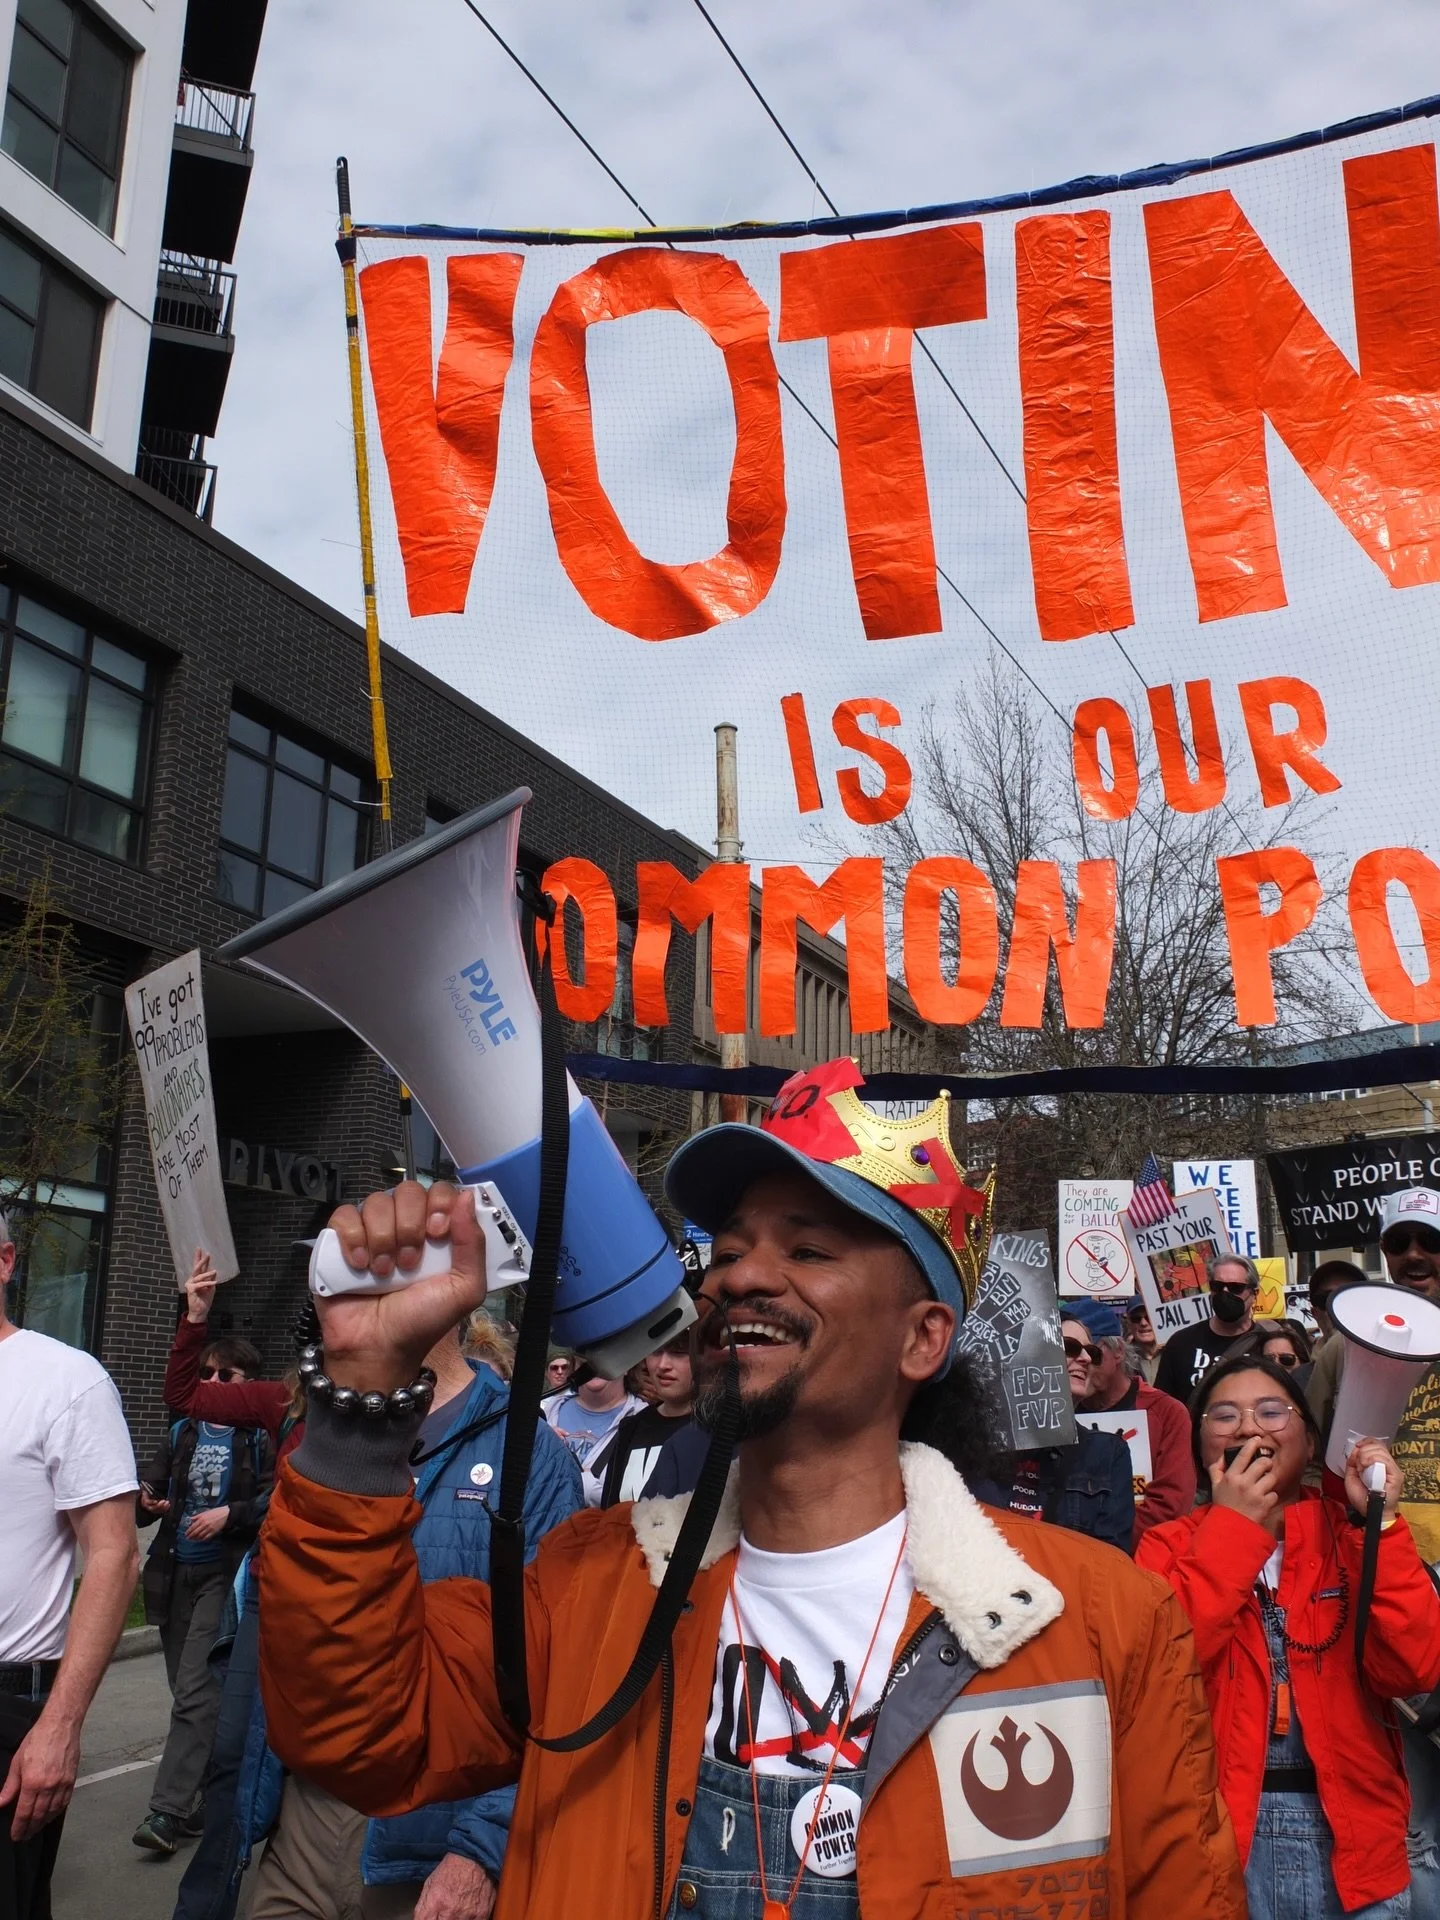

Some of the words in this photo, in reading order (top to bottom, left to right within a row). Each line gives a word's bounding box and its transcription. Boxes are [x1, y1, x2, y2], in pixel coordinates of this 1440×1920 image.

[780, 692, 913, 825] IS
[1073, 676, 1343, 822] OUR
[536, 856, 1116, 1037] OMMON
[442, 975, 487, 1056] PyleUSA.com
[460, 958, 517, 1047] PYLE
[135, 1024, 159, 1072] 99
[155, 1013, 205, 1066] PROBLEMS
[163, 1066, 178, 1091] AND
[157, 1152, 175, 1182] ARE
[175, 1113, 201, 1151] MOST
[168, 1174, 182, 1199] OF
[181, 1143, 209, 1180] THEM
[1188, 1165, 1232, 1186] WE
[1333, 1159, 1424, 1189] PEOPLE
[1064, 1184, 1088, 1199] They
[1092, 1187, 1108, 1196] are
[1064, 1197, 1119, 1211] COMING
[1291, 1201, 1359, 1226] STAND
[992, 1233, 1049, 1269] KINGS
[1136, 1227, 1169, 1252] PAST
[1173, 1217, 1216, 1242] YOUR
[990, 1273, 1020, 1306] BLM
[1155, 1304, 1190, 1330] JAIL
[1011, 1365, 1063, 1397] FDT
[1015, 1397, 1067, 1430] FVP
[814, 1832, 856, 1862] POWER
